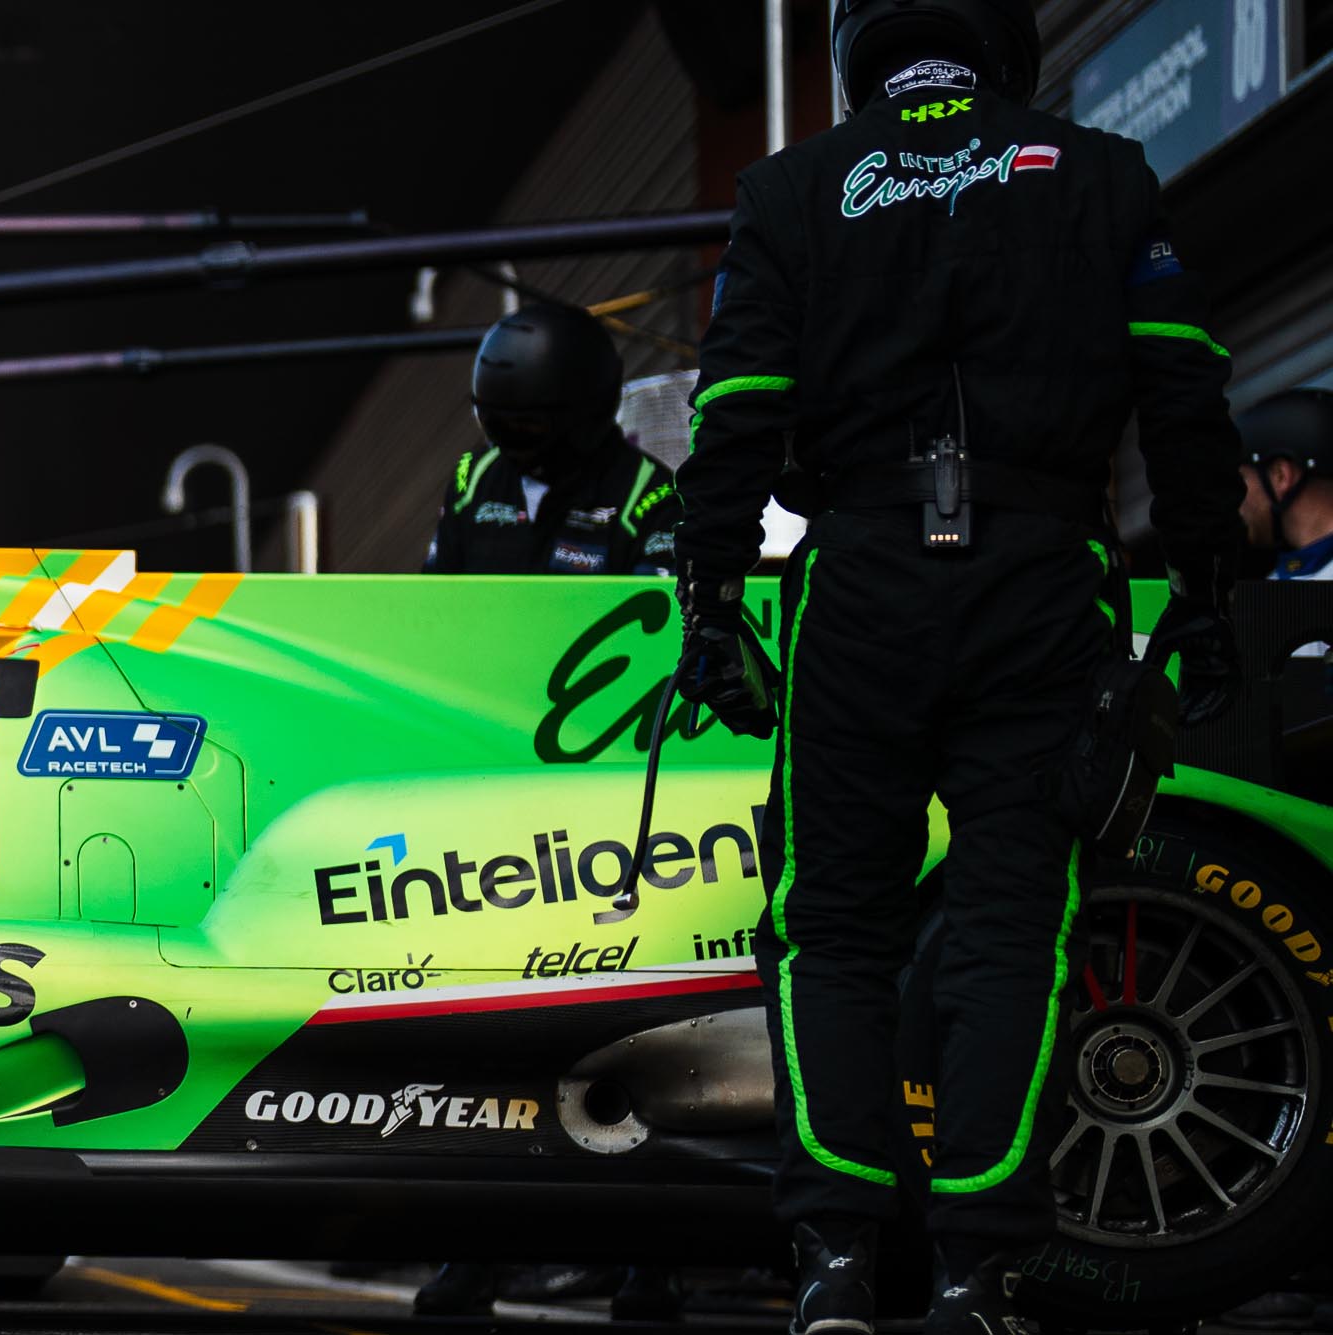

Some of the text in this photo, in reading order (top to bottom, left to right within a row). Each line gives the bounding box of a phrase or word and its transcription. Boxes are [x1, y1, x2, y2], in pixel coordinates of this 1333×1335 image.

[901, 98, 974, 123] HRX
[841, 144, 1020, 218] Europol
[47, 726, 121, 753] AVL
[47, 761, 147, 773] RACETECH
[521, 935, 640, 980] telcel
[327, 966, 426, 995] Claro
